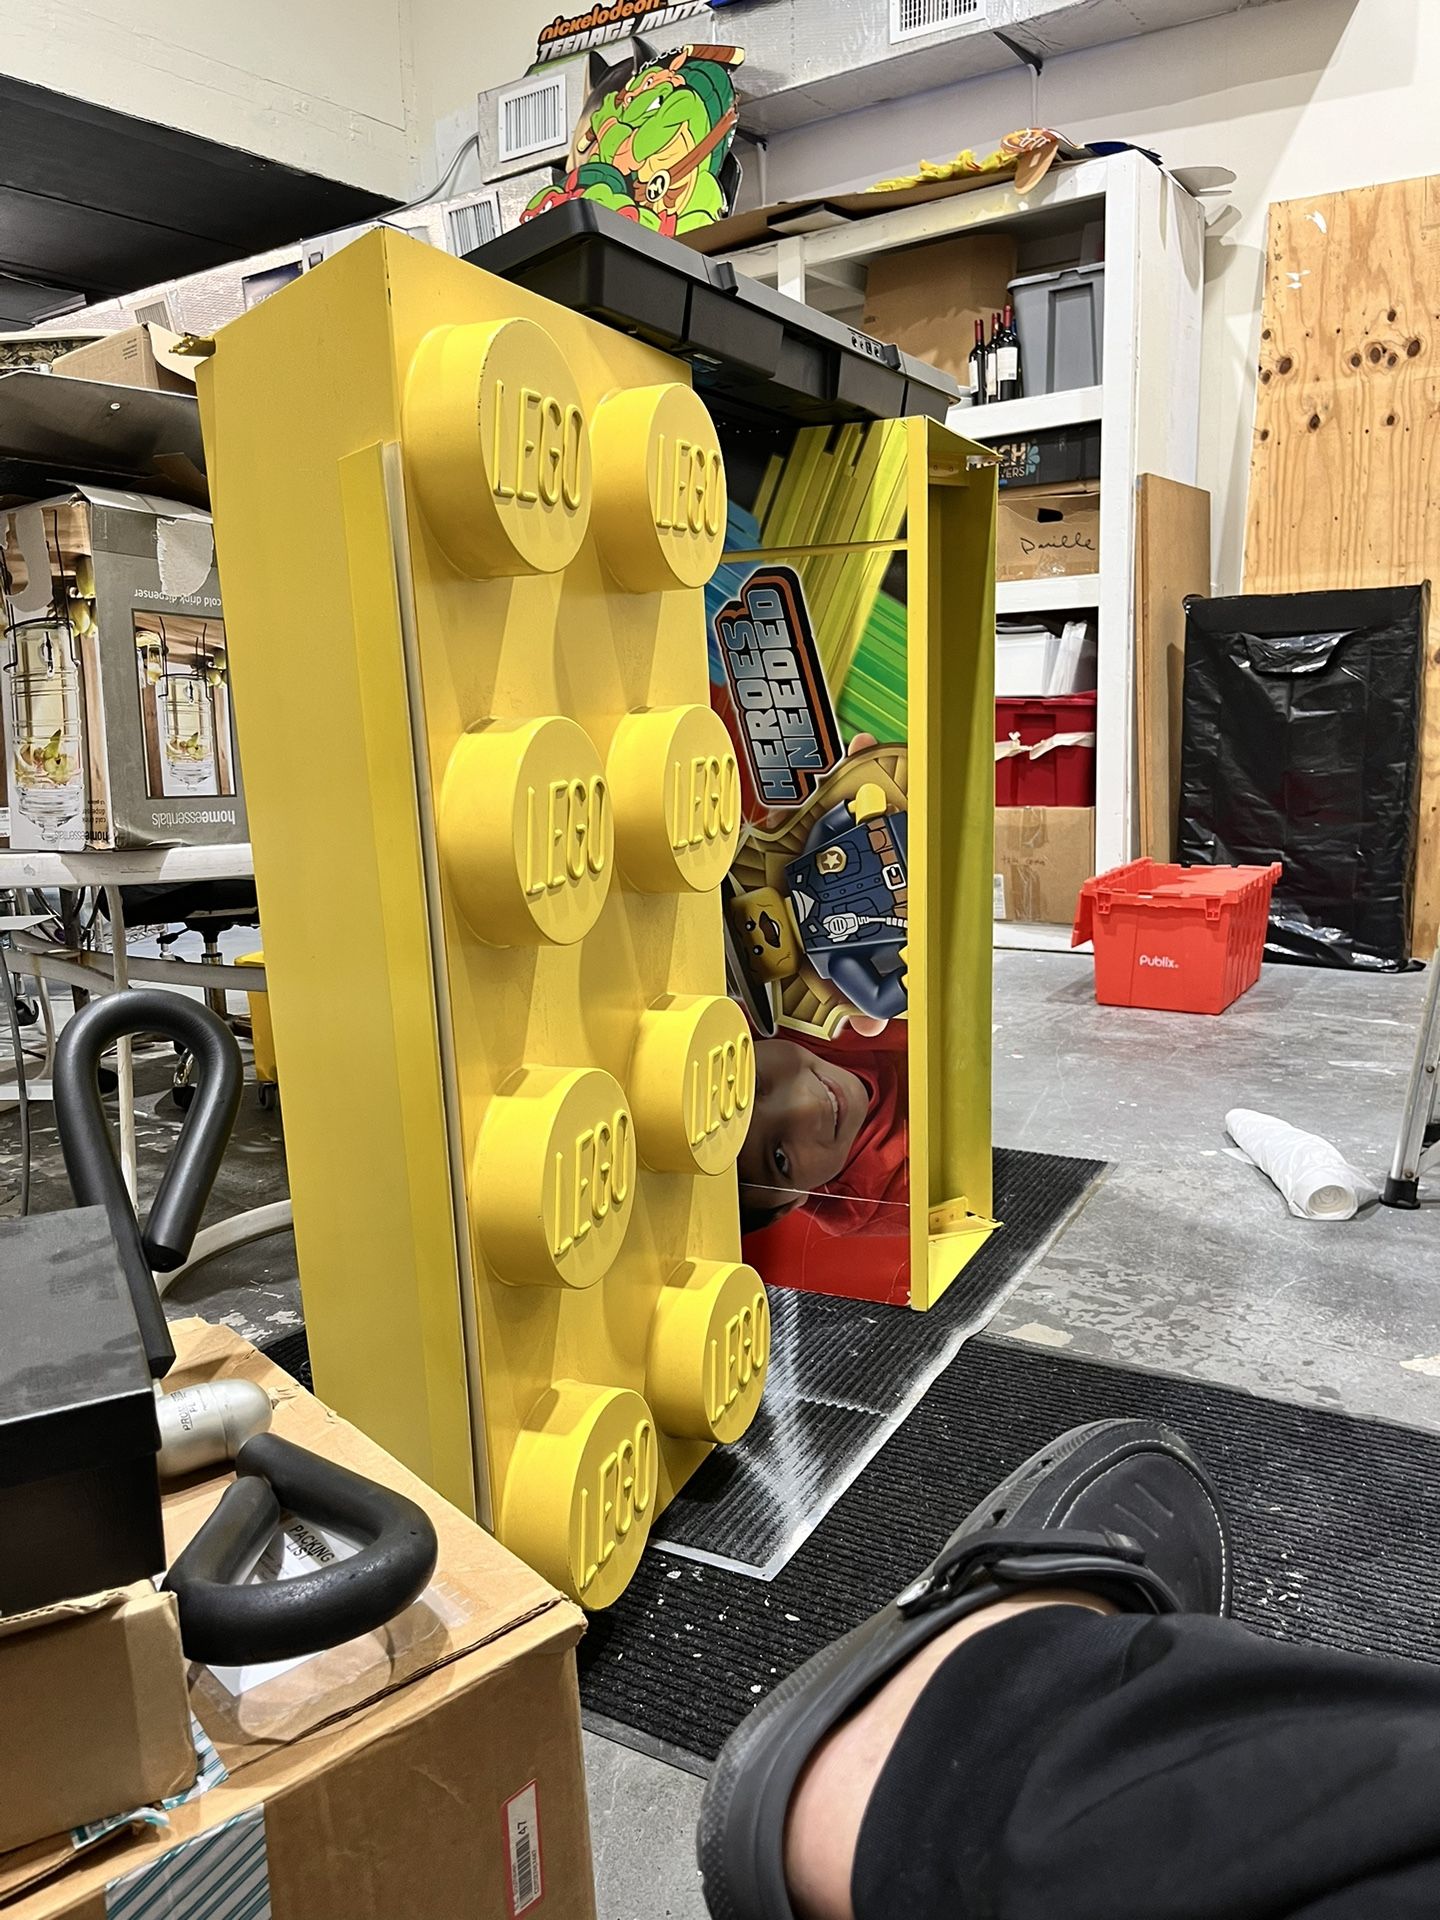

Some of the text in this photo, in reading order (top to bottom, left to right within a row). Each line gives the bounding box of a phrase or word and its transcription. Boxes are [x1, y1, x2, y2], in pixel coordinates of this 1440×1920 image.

[538, 18, 635, 64] TEENAGE
[493, 379, 583, 510] LEGO
[656, 433, 722, 536] LEGO
[204, 597, 222, 607] cold
[722, 621, 797, 798] HEROES
[747, 589, 823, 767] NEEDED
[151, 810, 236, 828] homeessentials
[526, 775, 606, 895] LEGO
[673, 753, 735, 850] LEGO
[1139, 954, 1175, 968] Publix
[691, 1032, 750, 1146] LEGO
[554, 1109, 628, 1257] LEGO
[711, 1292, 765, 1424] LEGO
[286, 1542, 314, 1561] LIST
[289, 1525, 335, 1562] PACKING
[580, 1419, 650, 1589] LEGO
